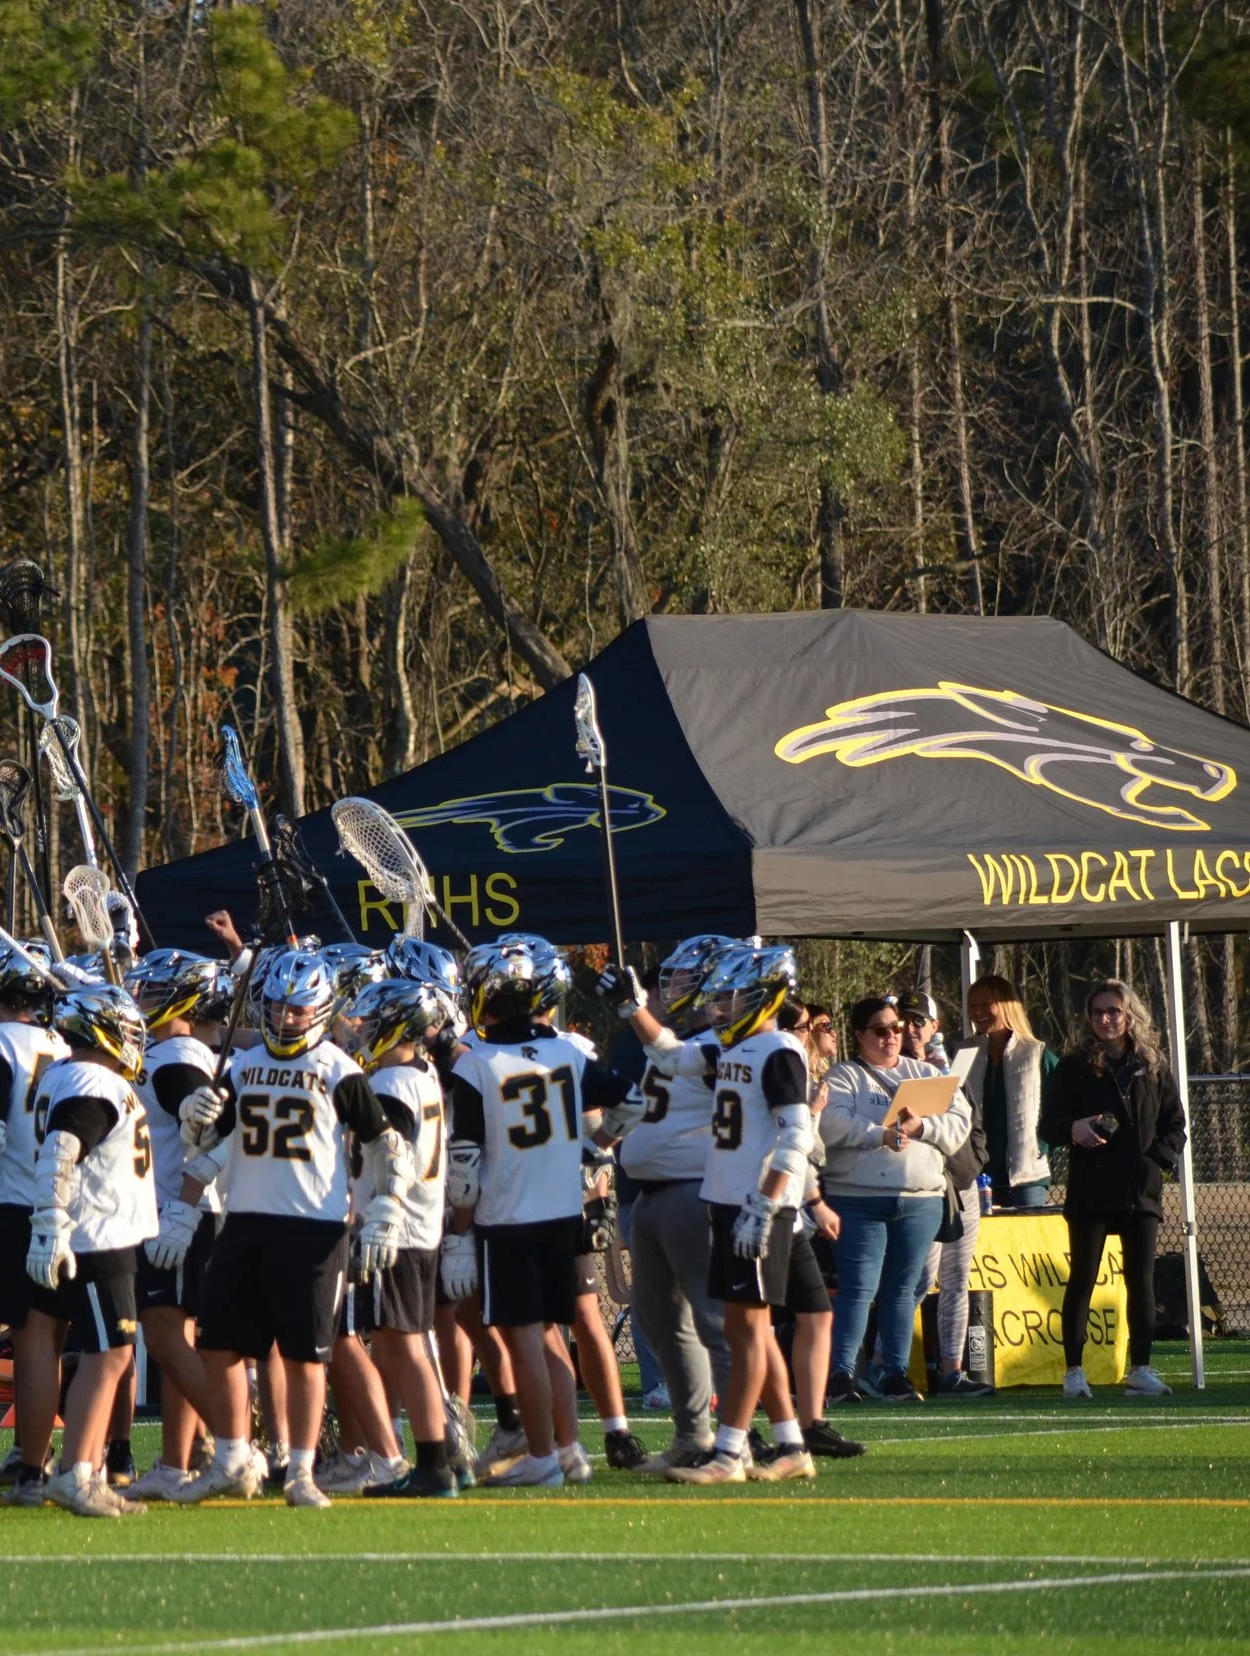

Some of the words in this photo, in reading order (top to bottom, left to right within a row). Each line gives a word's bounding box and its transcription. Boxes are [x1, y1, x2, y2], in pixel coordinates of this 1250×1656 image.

[967, 849, 1156, 905] WILDCAT
[1166, 848, 1250, 899] LAC
[238, 1093, 315, 1162] 52
[500, 1064, 579, 1151] 31
[712, 1089, 743, 1151] 9
